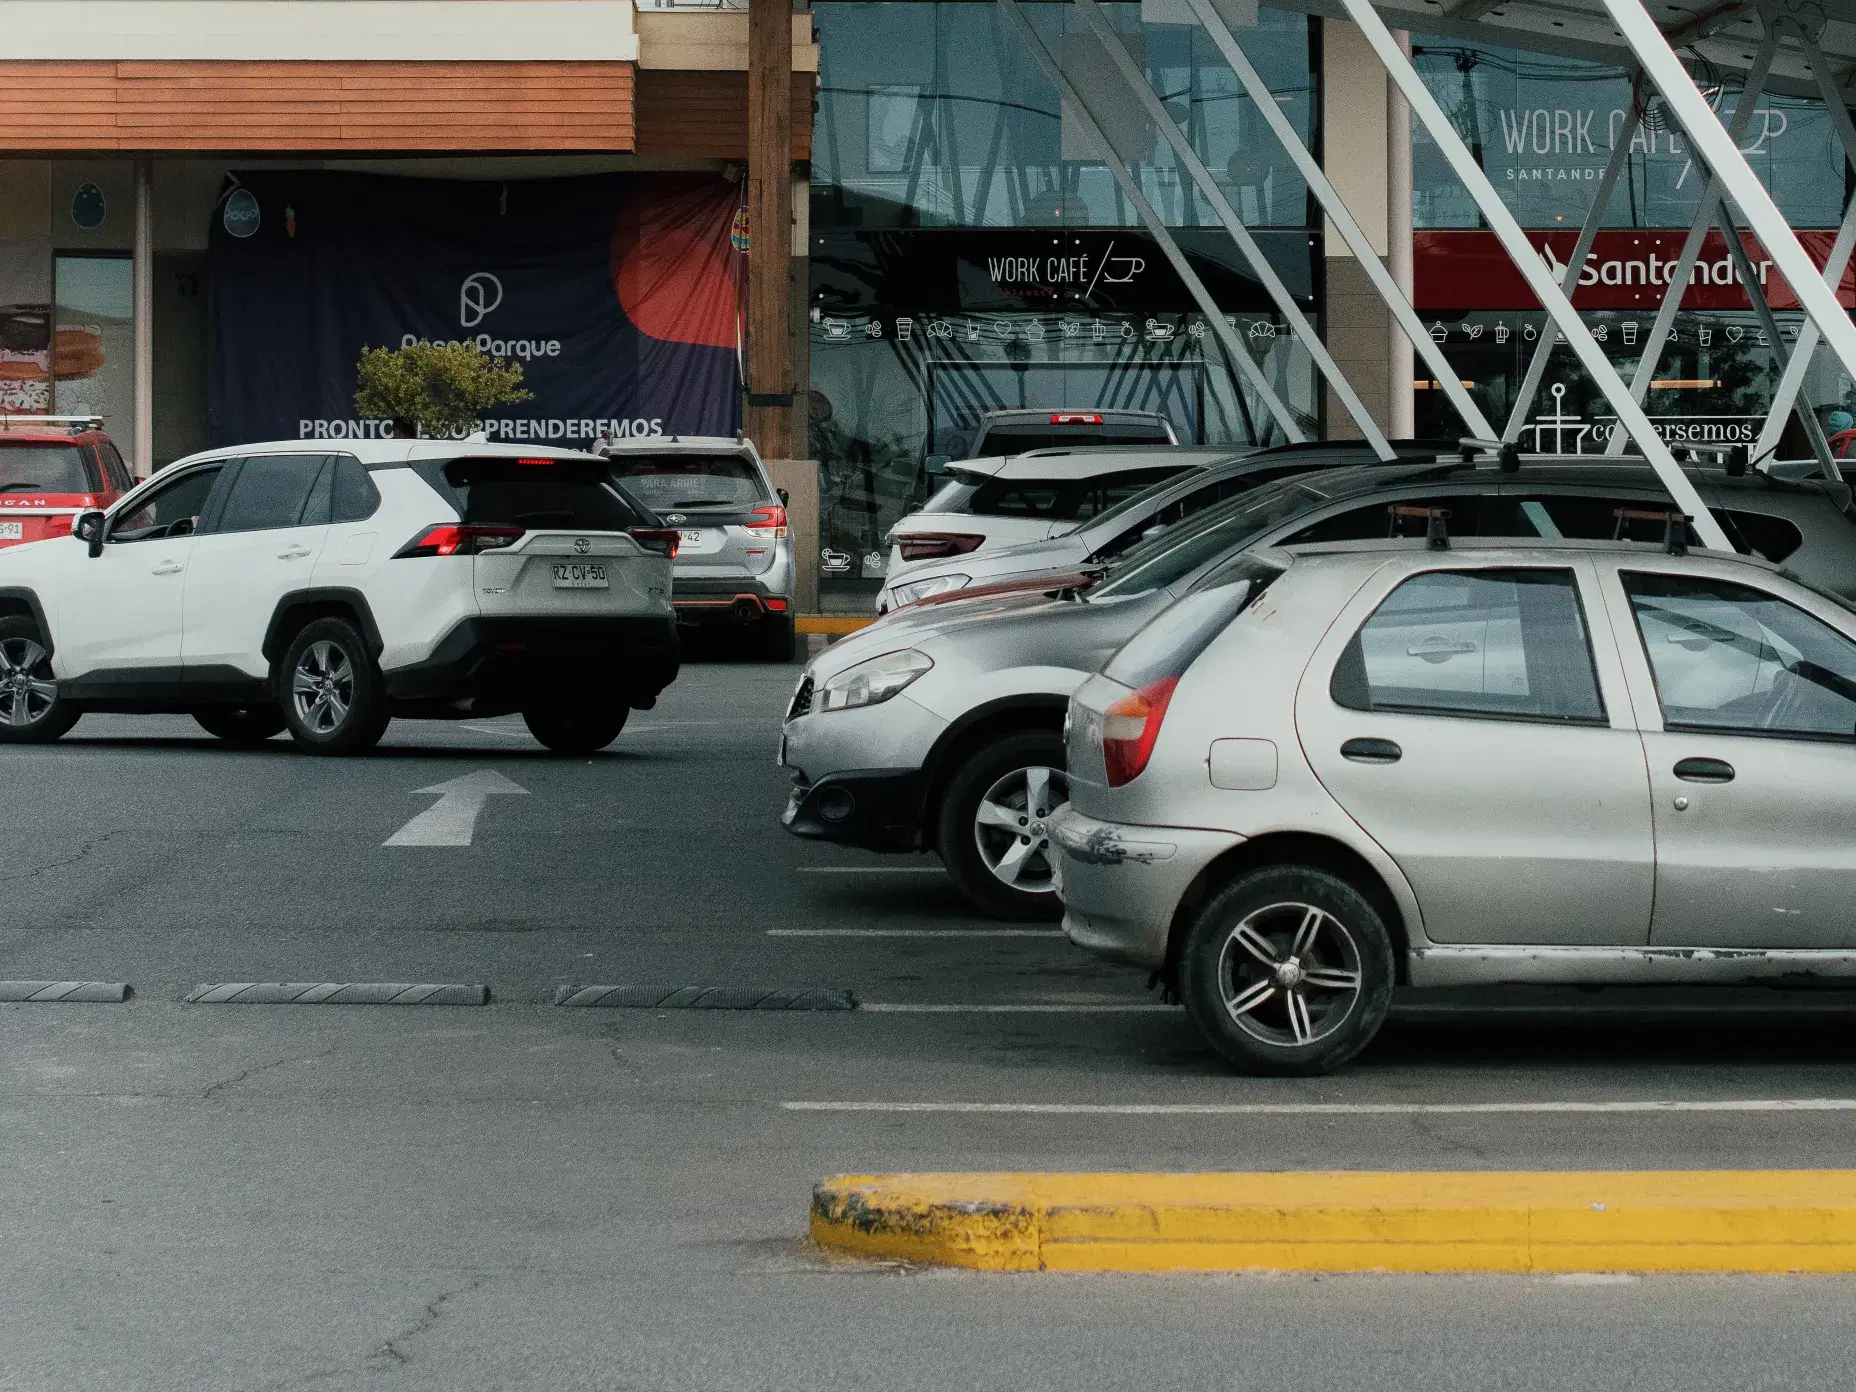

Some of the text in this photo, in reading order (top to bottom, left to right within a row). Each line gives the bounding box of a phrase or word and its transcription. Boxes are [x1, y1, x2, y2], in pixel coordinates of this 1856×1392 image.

[1500, 109, 1596, 154] WORK
[1506, 169, 1621, 180] SANTANDE
[988, 253, 1089, 282] WORK CAFÉ
